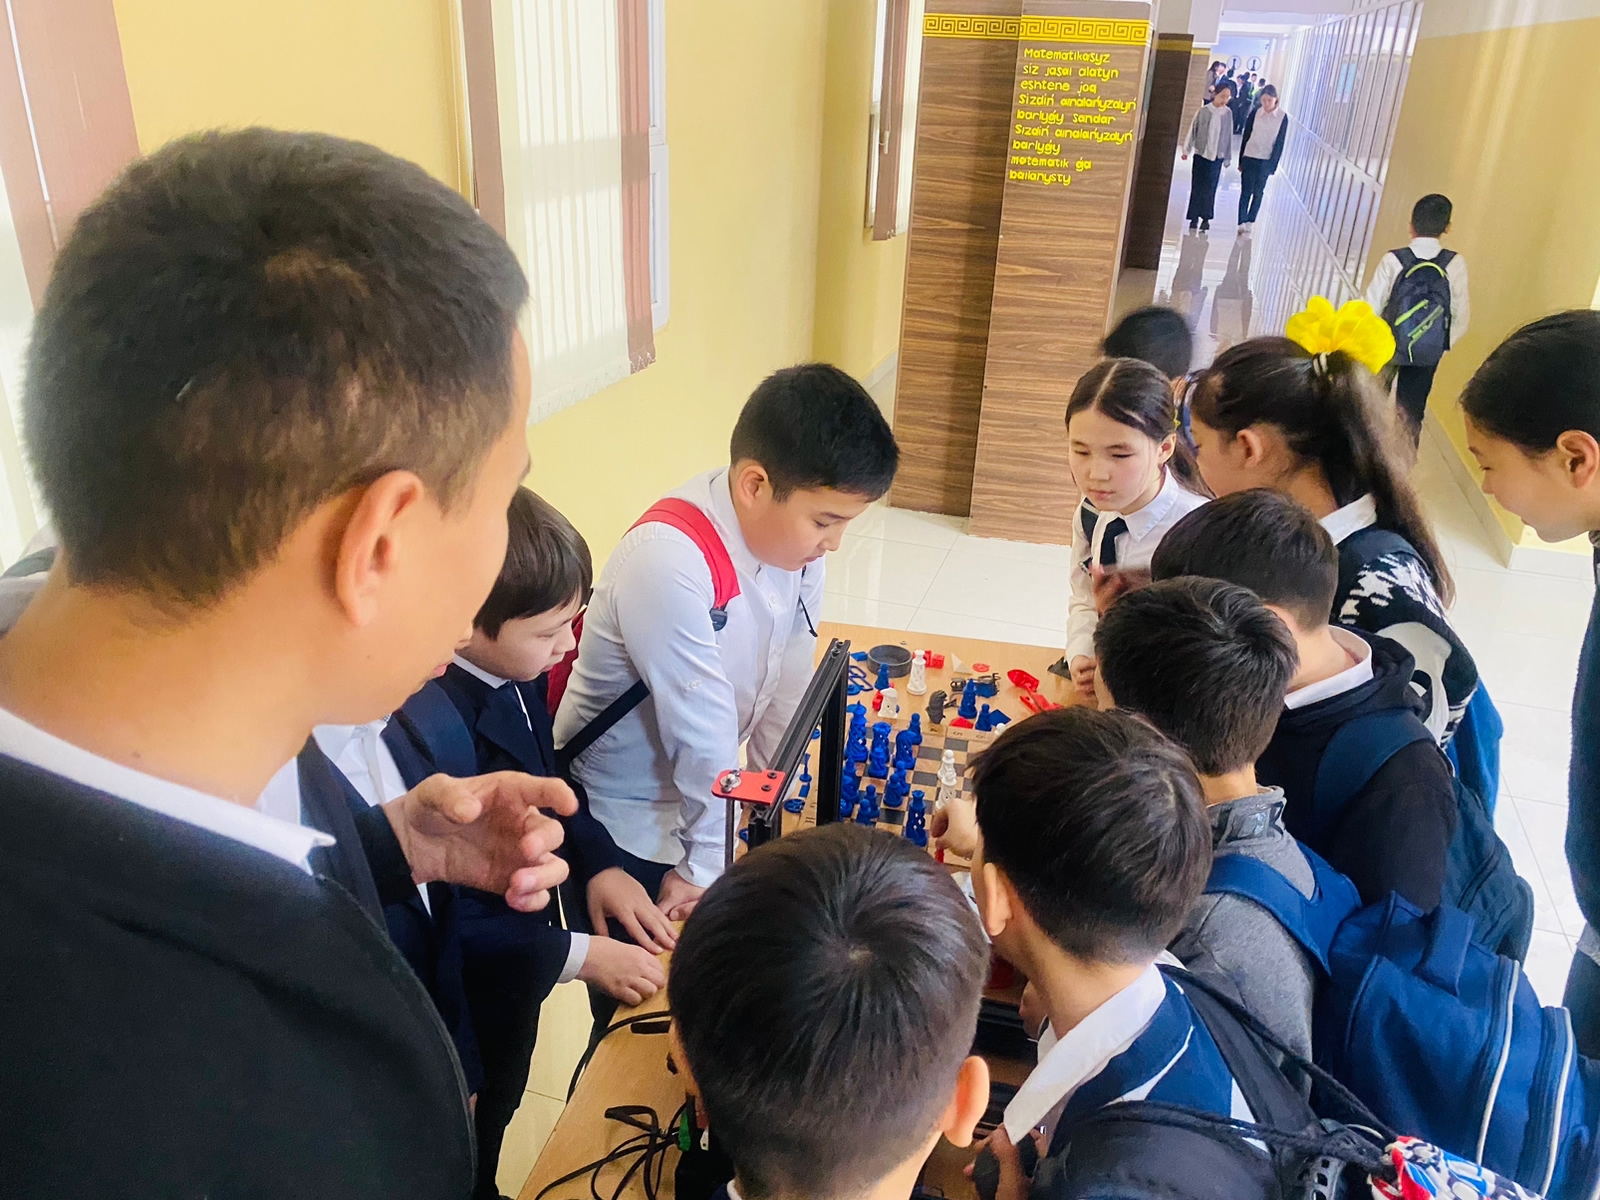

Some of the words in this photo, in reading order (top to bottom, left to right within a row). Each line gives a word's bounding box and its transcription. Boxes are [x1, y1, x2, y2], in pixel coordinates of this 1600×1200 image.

[1022, 63, 1040, 75] siz
[1078, 66, 1119, 82] alatyn
[1020, 79, 1071, 92] eshtene
[1077, 81, 1098, 94] joq
